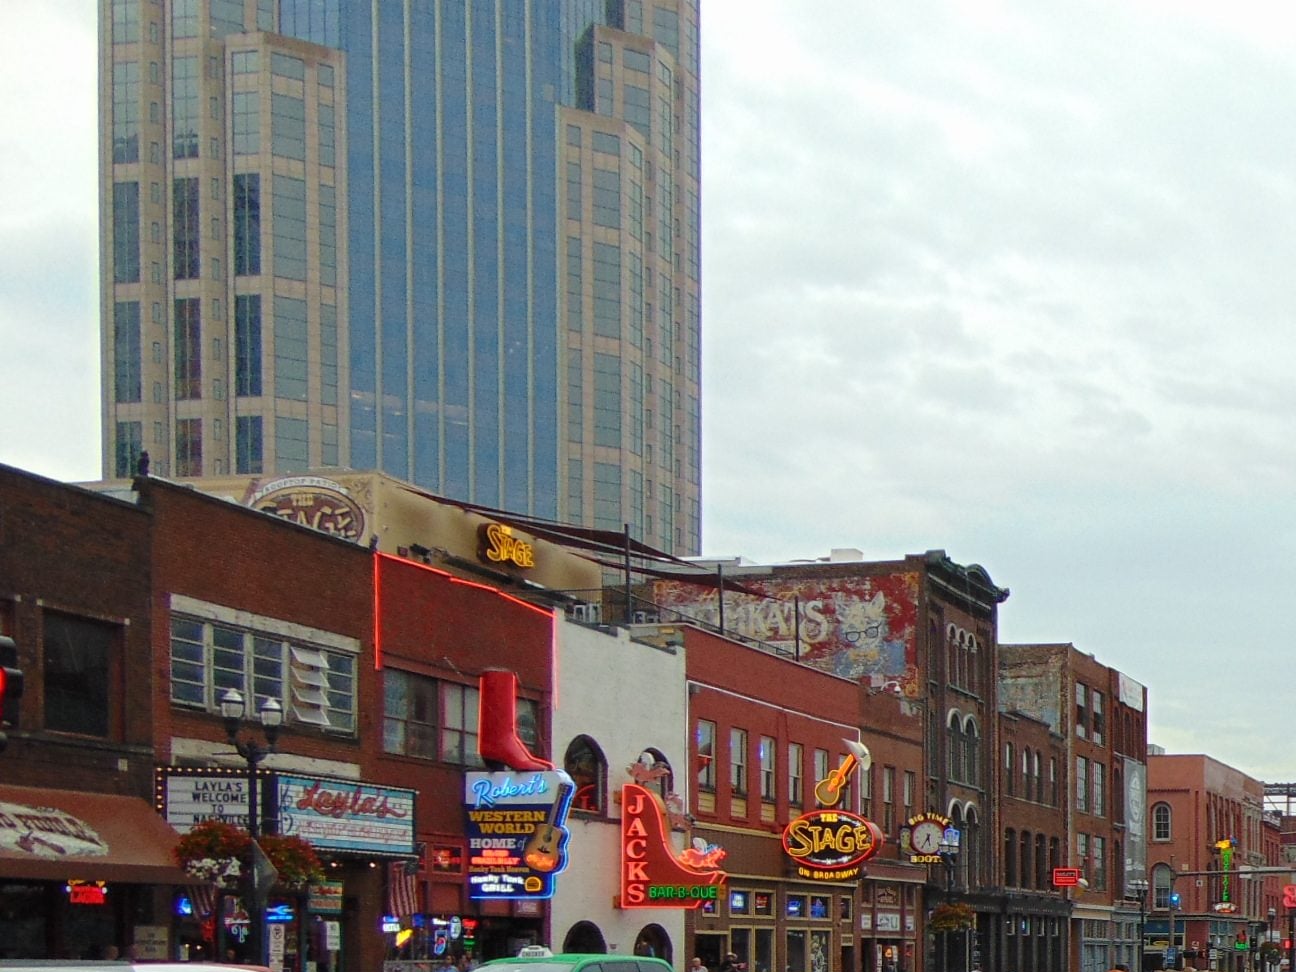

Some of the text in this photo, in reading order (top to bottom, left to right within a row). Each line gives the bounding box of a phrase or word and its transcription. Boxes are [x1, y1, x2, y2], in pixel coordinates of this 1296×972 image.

[487, 525, 534, 567] STAGE
[195, 781, 243, 792] LAYLA'S
[471, 774, 548, 808] Robert's
[192, 792, 247, 803] WELCOME
[296, 781, 408, 819] Layla's
[212, 803, 224, 814] TO
[469, 811, 546, 822] WESTERN
[820, 813, 838, 822] THE
[908, 813, 925, 826] BIG
[479, 823, 535, 834] WORLD
[470, 838, 517, 849] HOME
[788, 820, 871, 857] STAGE
[627, 795, 650, 902] JACKS
[813, 867, 858, 880] BROADWAY
[649, 886, 718, 899] BAR-B-QUE
